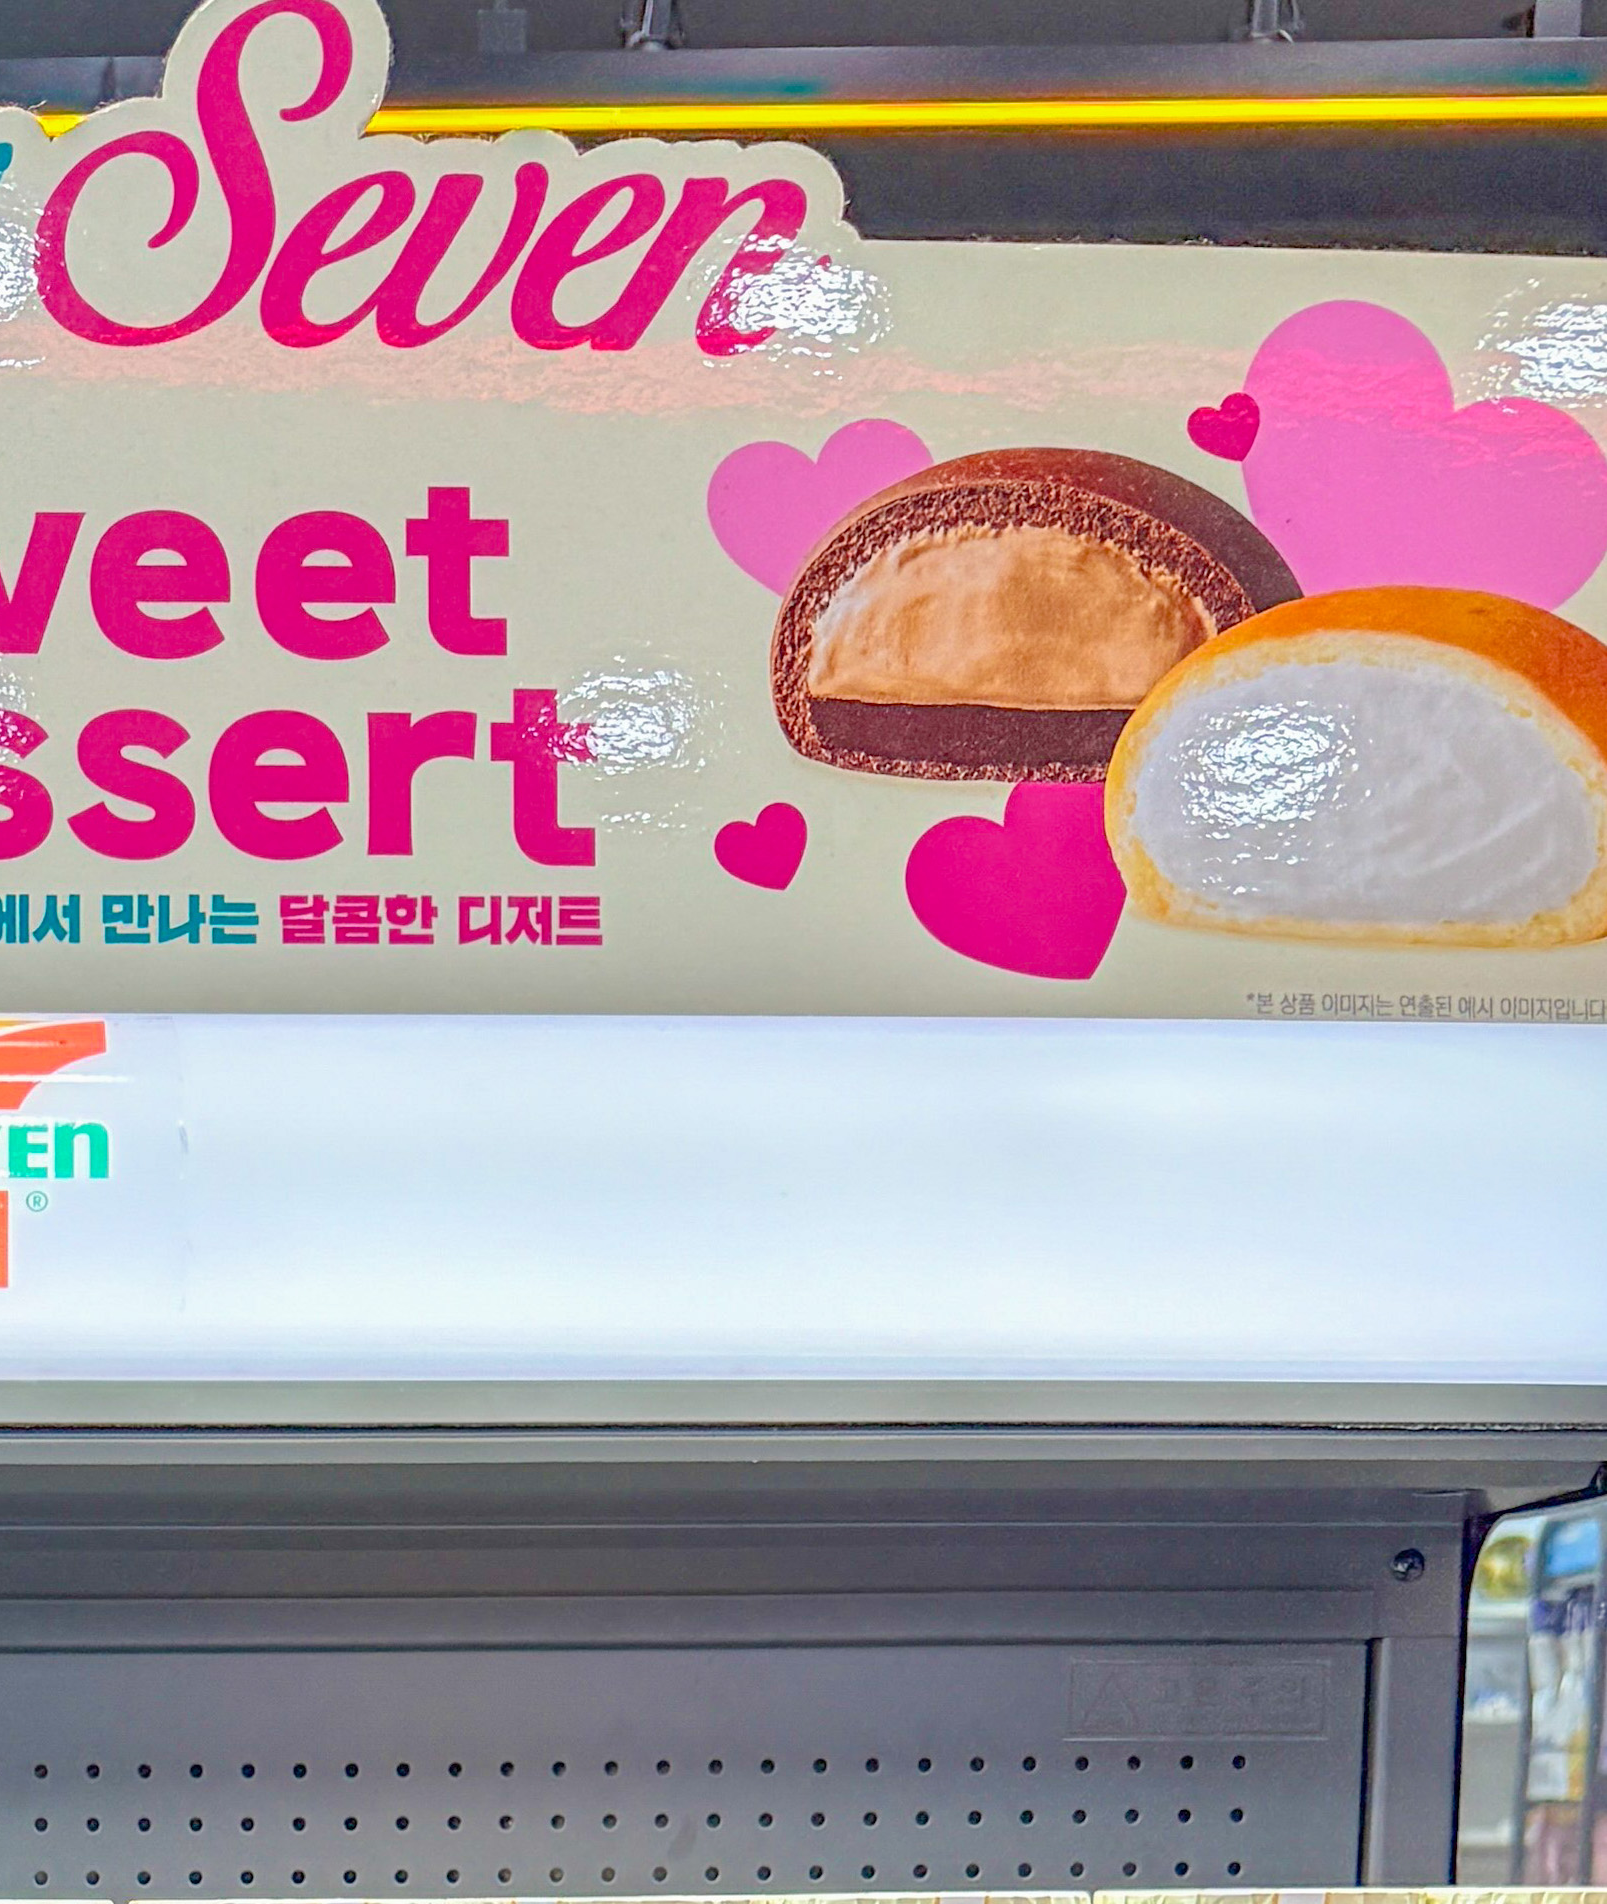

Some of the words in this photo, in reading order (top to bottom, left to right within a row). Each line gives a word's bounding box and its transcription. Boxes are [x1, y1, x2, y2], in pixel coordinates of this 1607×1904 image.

[42, 0, 807, 357] Seven
[101, 896, 259, 945] 만나는
[280, 896, 437, 945] 달콤한
[458, 896, 603, 946] 디저트
[1280, 994, 1315, 1016] 상품
[1322, 994, 1393, 1016] 이미지는
[1399, 995, 1452, 1018] 연출된
